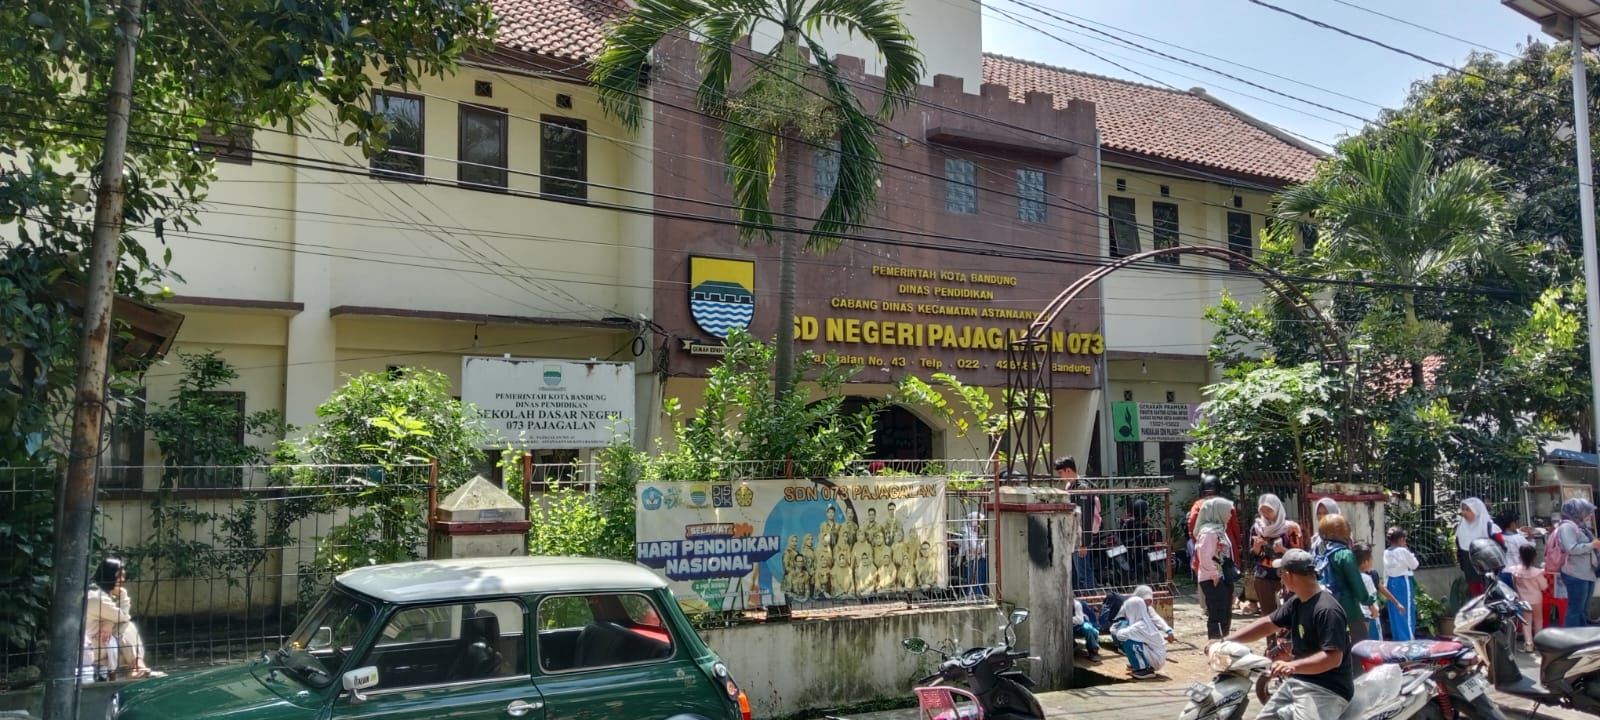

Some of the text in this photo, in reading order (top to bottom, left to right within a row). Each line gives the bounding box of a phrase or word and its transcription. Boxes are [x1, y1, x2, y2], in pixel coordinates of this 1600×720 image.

[872, 265, 1017, 286] PEMERINTAH KOTA BANDUNG
[899, 284, 994, 300] DINAS PENDIDIKAN
[831, 297, 878, 310] CABANG
[882, 301, 914, 313] DINAS
[918, 304, 978, 317] KECAMATAN
[825, 317, 924, 347] NEGERI
[1067, 332, 1104, 355] 073
[891, 357, 906, 367] 43
[920, 358, 943, 369] Telp
[957, 359, 980, 369] 022
[1052, 363, 1091, 375] Bandung
[495, 392, 607, 402] PEMERINTAH KOTA BANDUNG
[540, 401, 588, 409] PENDIDIKAN
[477, 409, 623, 420] SEKOLAH DASAR NEGERI
[506, 420, 597, 430] 073 PAJAGALAN
[784, 483, 937, 502] SDN 073 PAJAGALAN
[690, 526, 728, 536] SELAMAT
[637, 536, 779, 559] HARI PENDIDIKAN
[666, 555, 753, 575] NASIONAL
